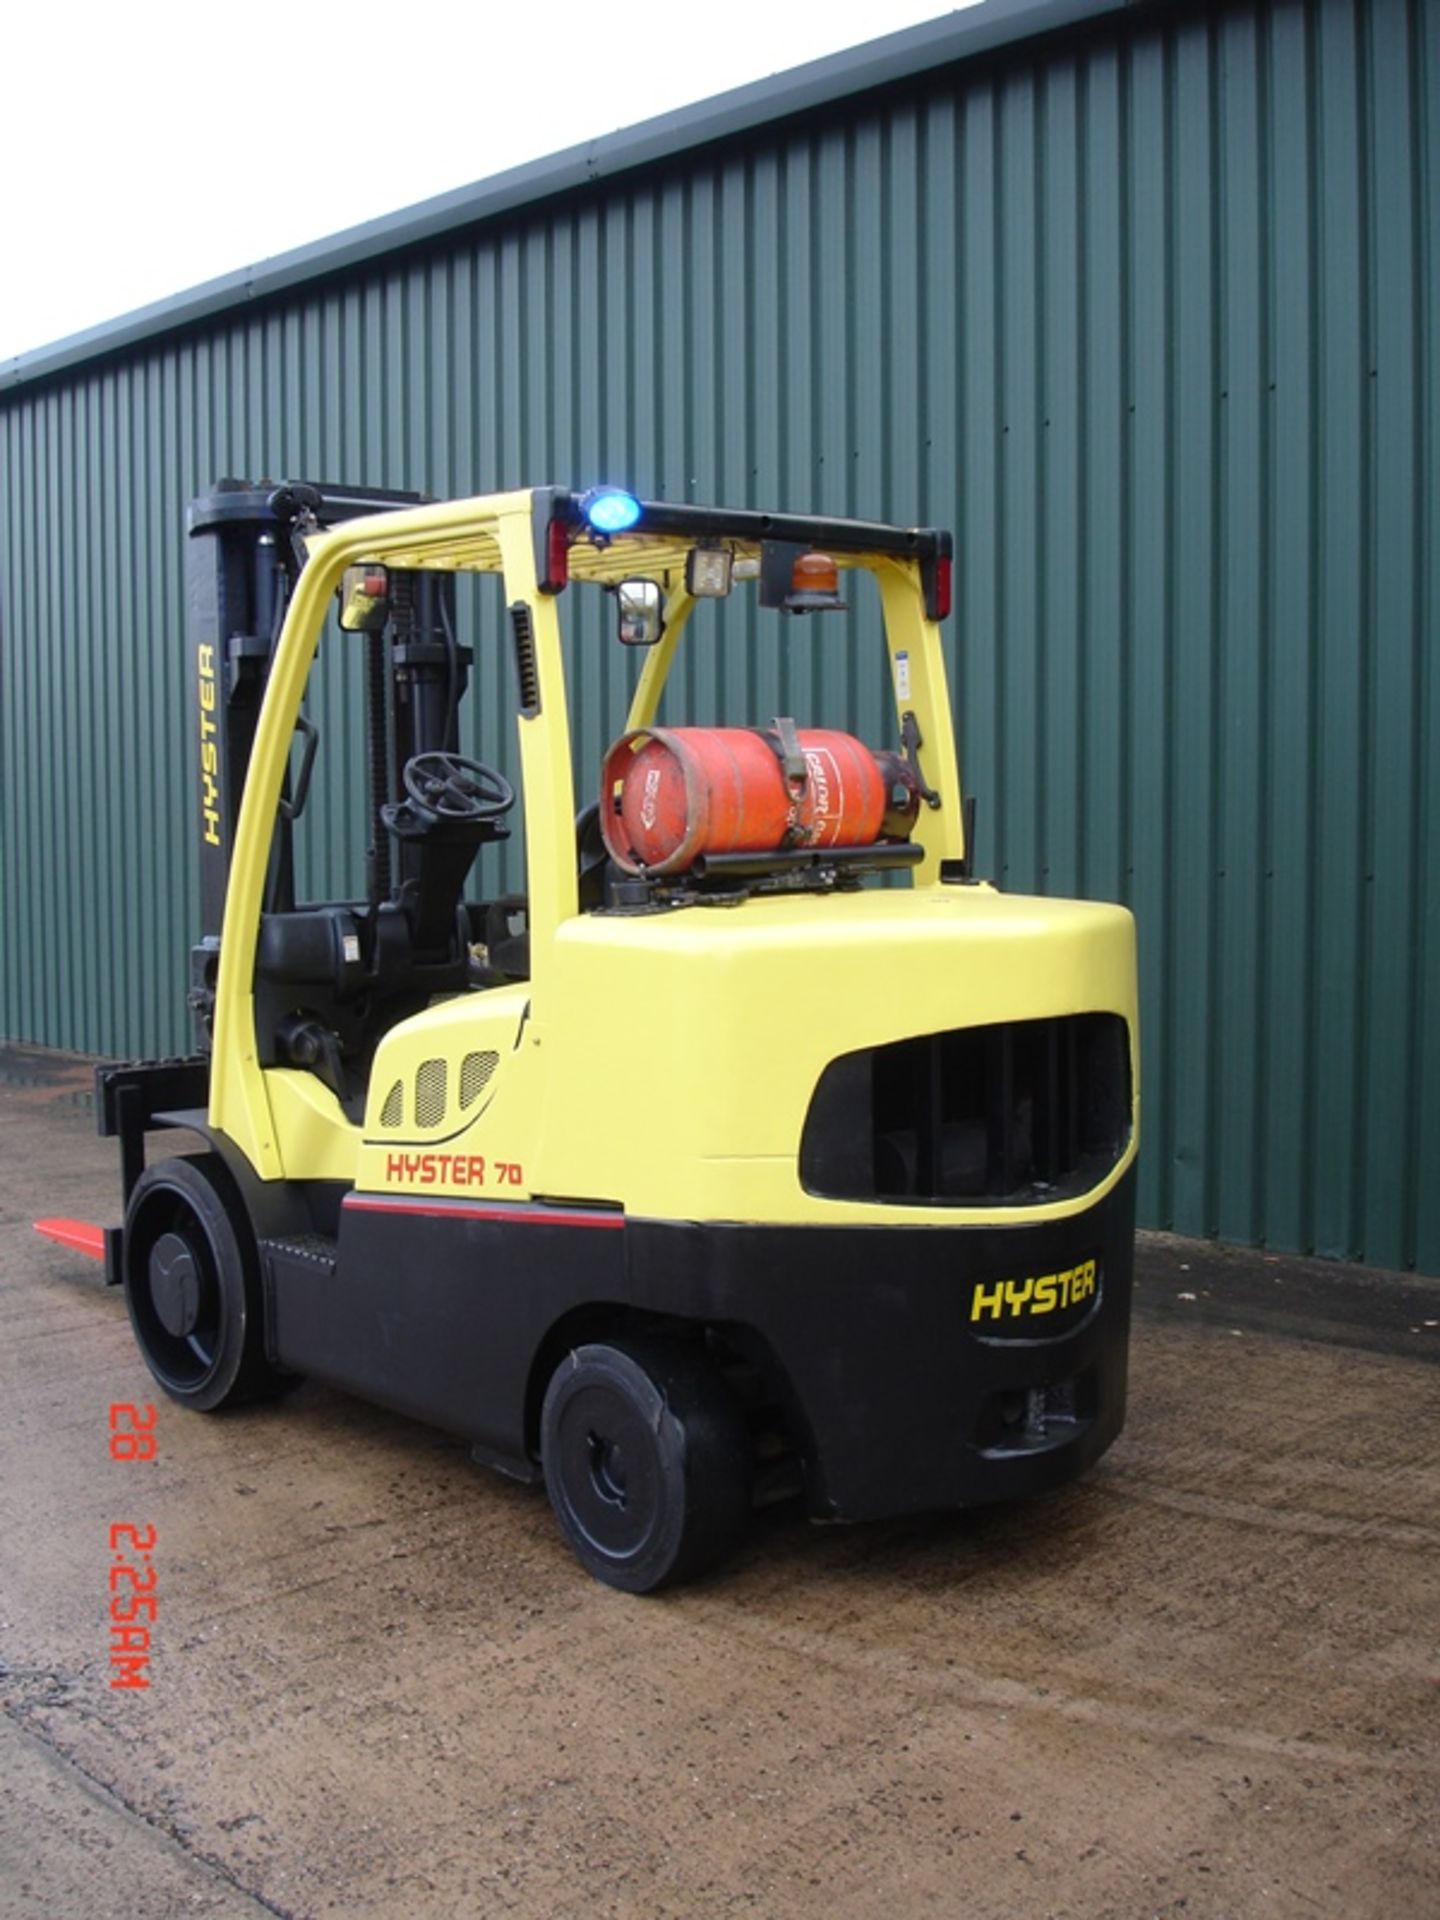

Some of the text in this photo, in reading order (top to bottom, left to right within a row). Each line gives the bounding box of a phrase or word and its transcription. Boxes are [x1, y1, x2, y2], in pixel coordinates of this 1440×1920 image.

[199, 643, 220, 846] HYSTER
[386, 1153, 523, 1186] HYSTER 70
[970, 1259, 1096, 1322] HYSTER
